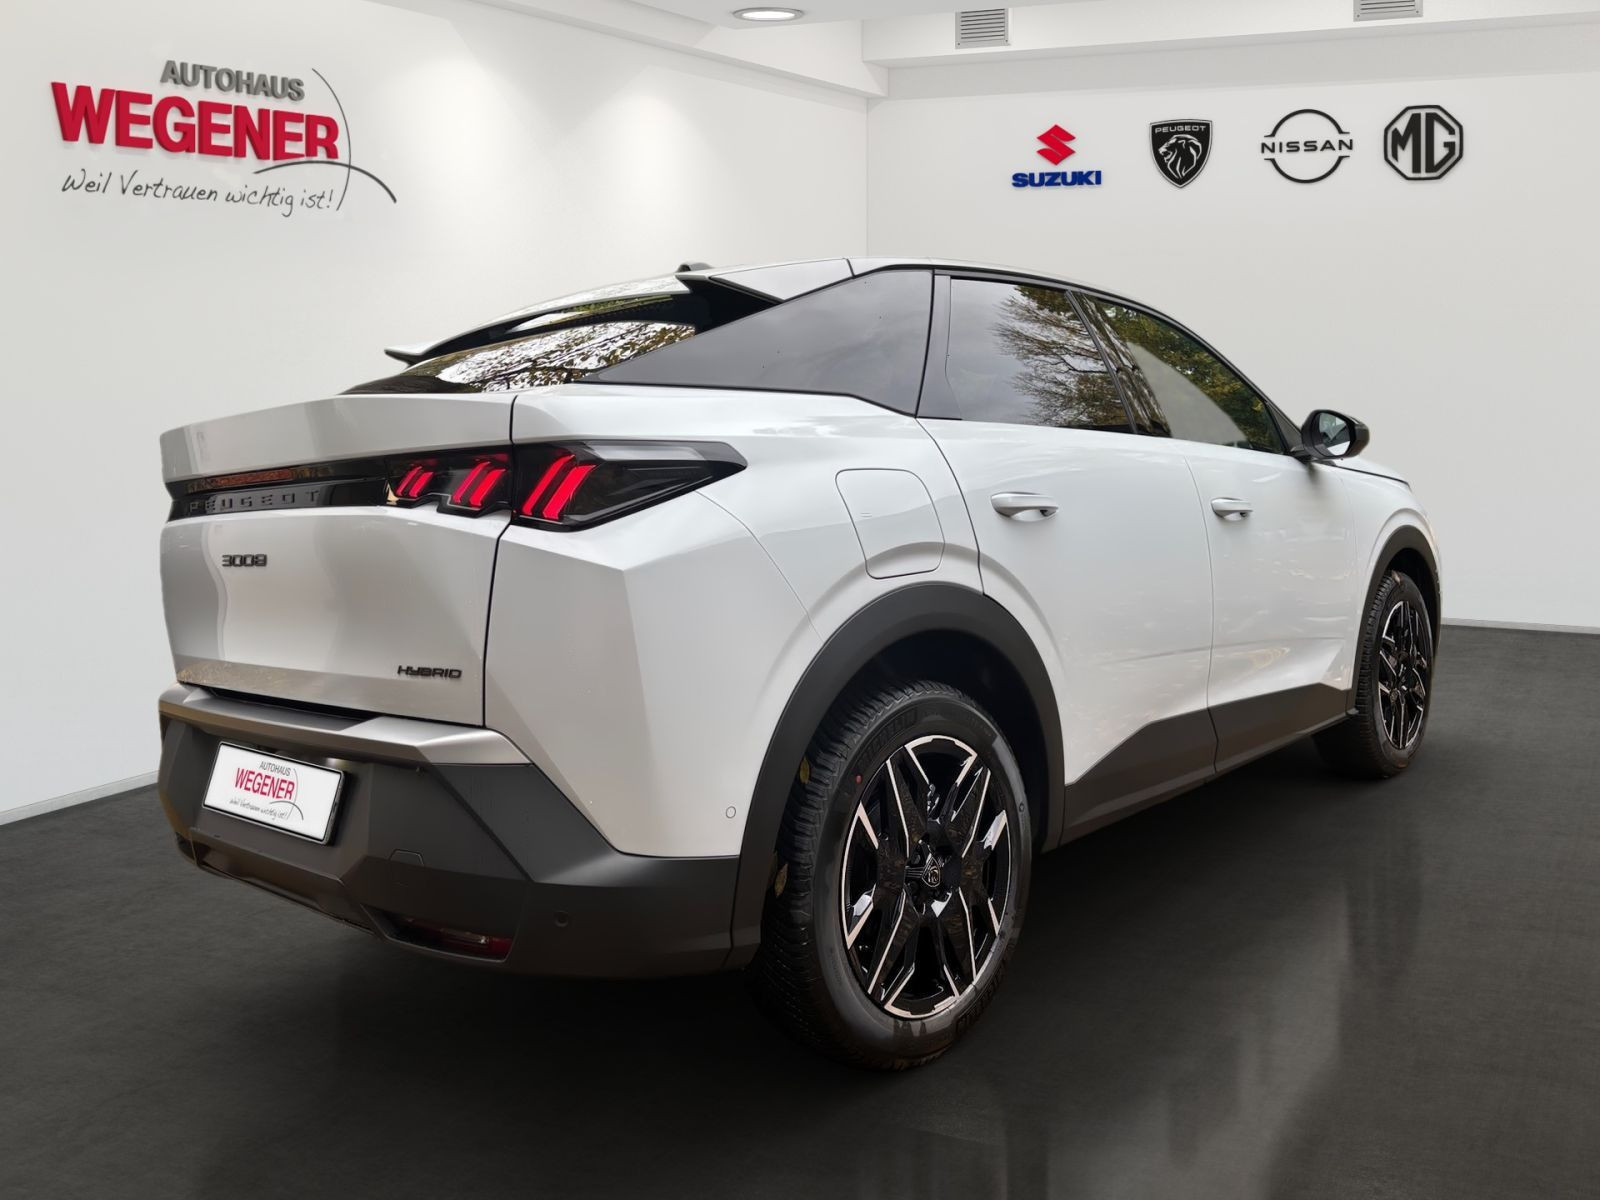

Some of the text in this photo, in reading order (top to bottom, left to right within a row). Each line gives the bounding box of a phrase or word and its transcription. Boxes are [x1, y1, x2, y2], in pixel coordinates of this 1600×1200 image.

[160, 60, 305, 101] AUTOHAUS
[51, 81, 339, 161] WEGENER
[1154, 124, 1207, 133] PEUGEOT
[1261, 138, 1353, 154] NISSAN
[1391, 112, 1456, 174] MG
[1011, 170, 1102, 188] SUZUKI
[62, 168, 333, 218] Weil Vertrauen wichtig ist!
[189, 490, 320, 512] PEUGEOT
[222, 553, 268, 568] 3008
[397, 664, 463, 679] HYBRID
[259, 761, 291, 777] AUTOHAUS
[235, 767, 295, 800] WEGENER
